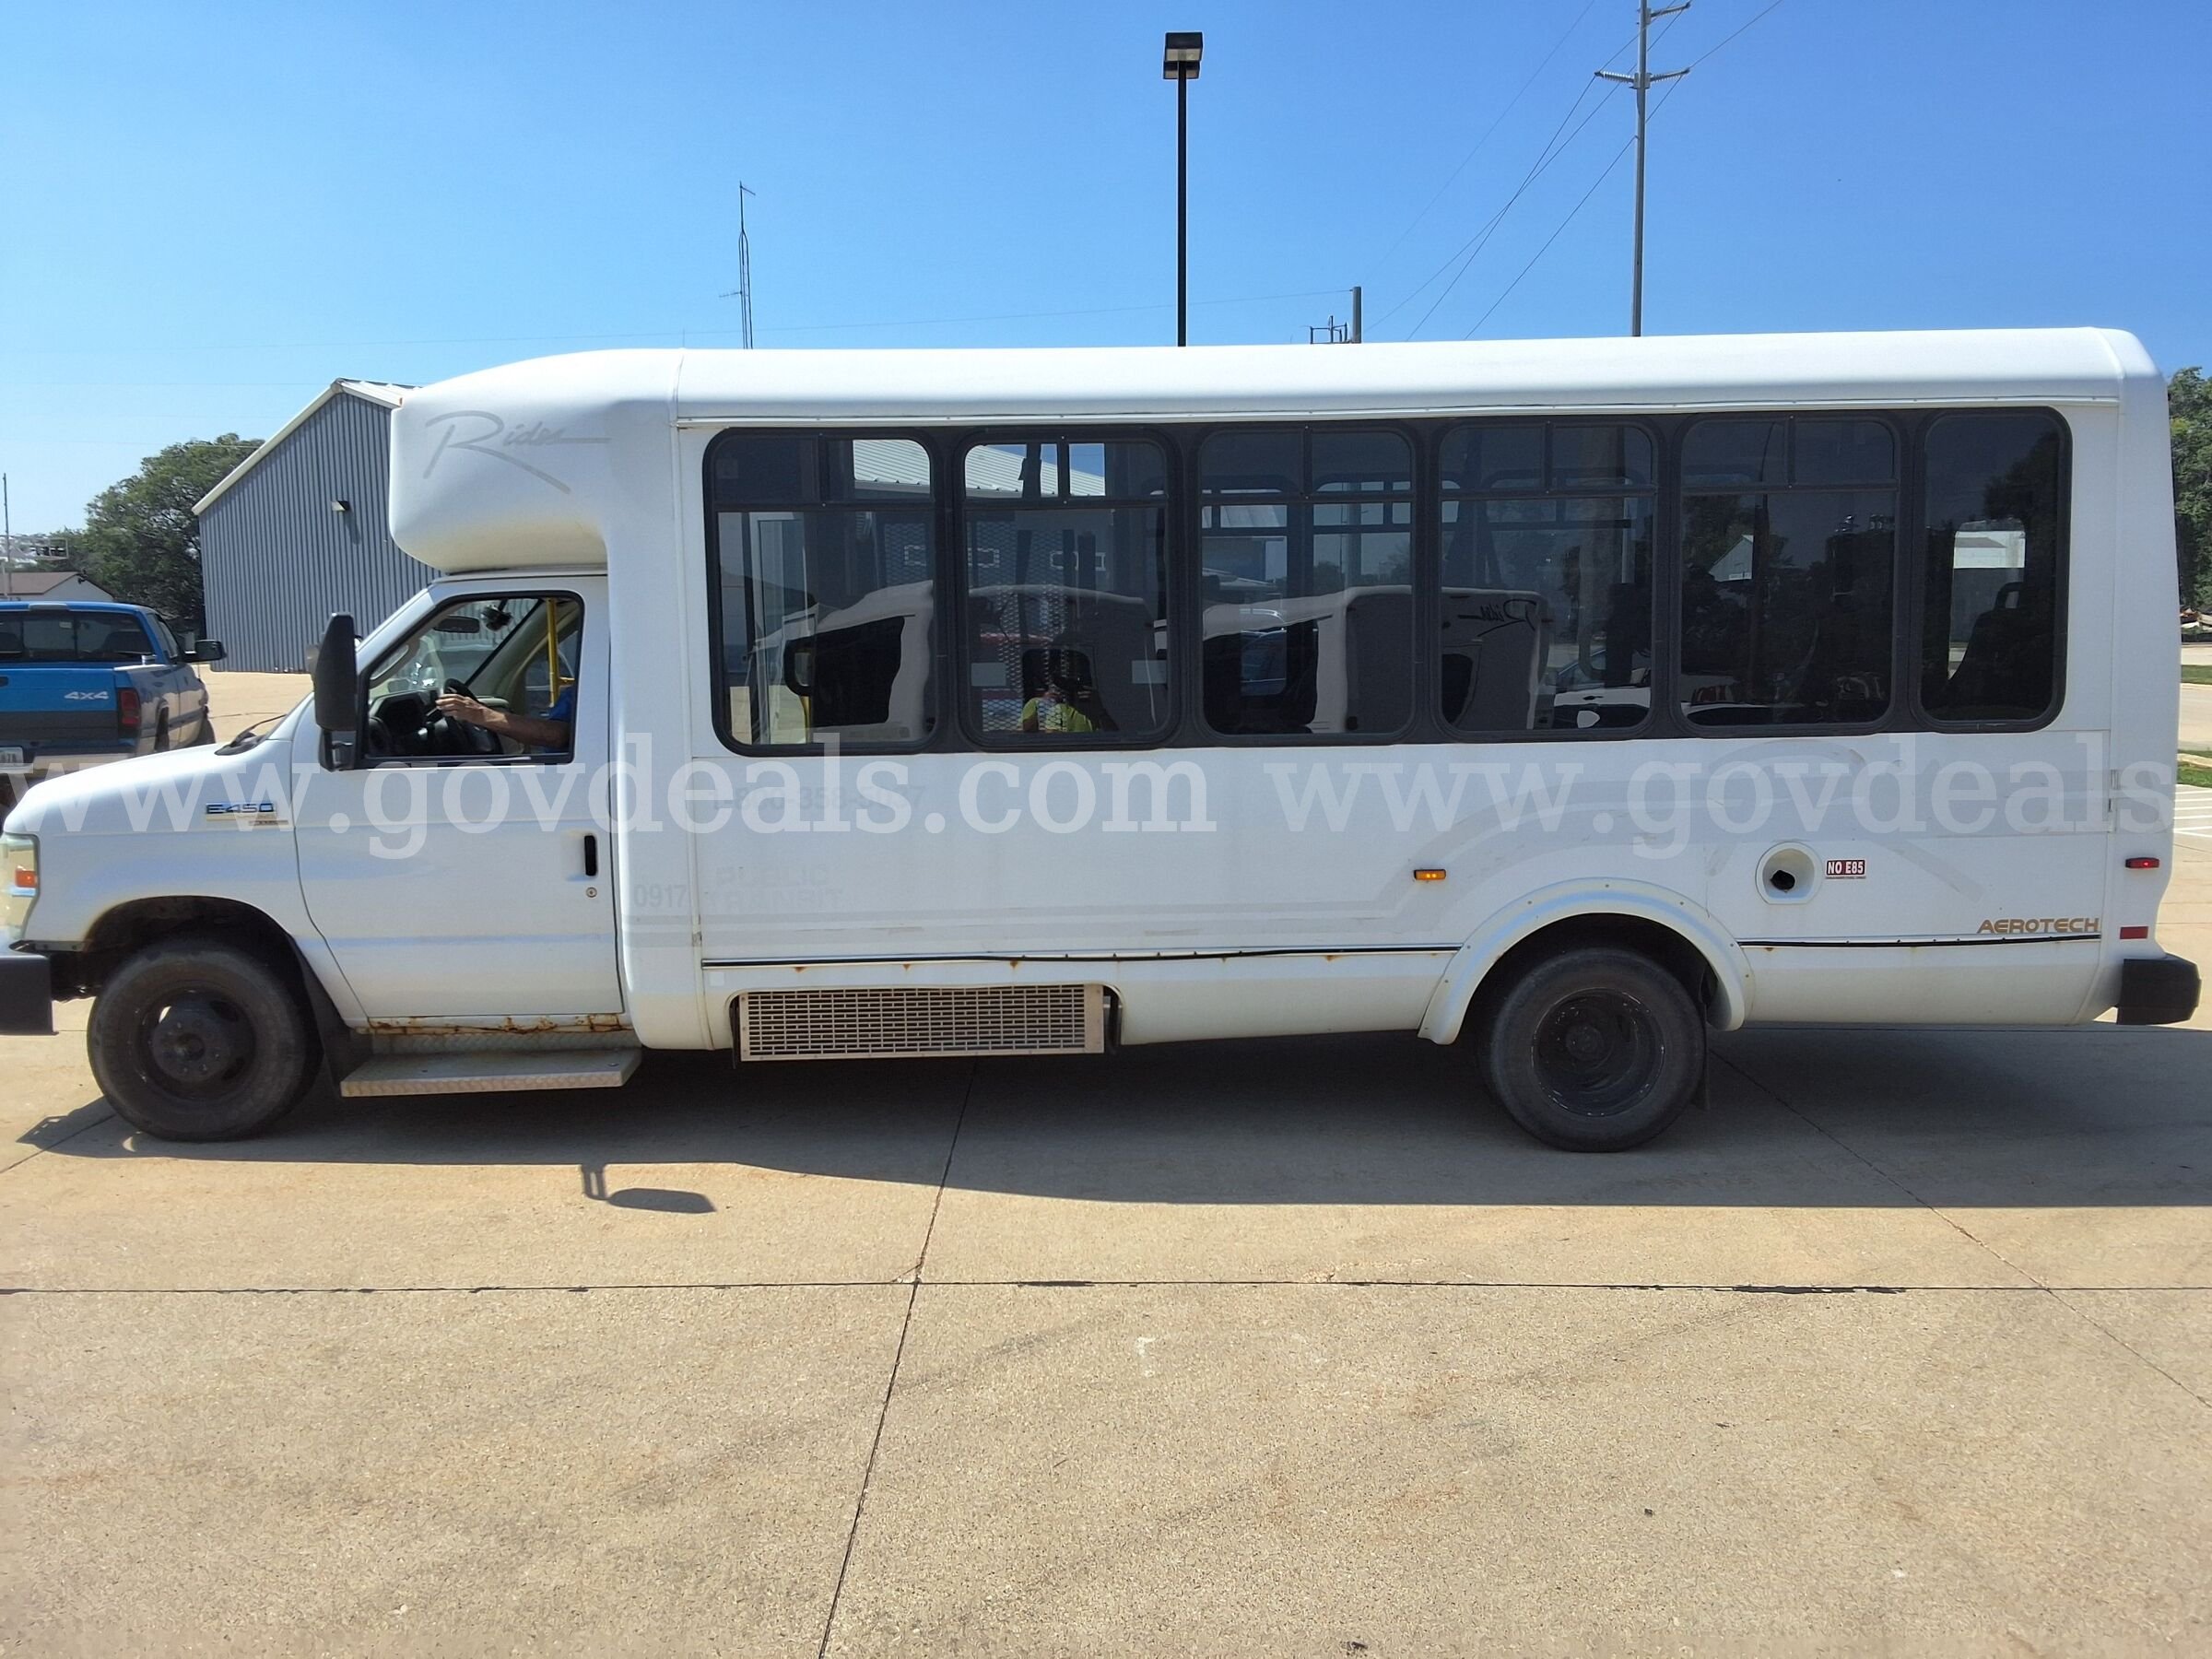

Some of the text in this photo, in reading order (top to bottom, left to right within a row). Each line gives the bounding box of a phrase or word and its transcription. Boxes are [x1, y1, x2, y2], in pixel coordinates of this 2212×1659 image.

[1827, 861, 1864, 875] NO E85
[633, 883, 688, 909] 0917
[1976, 918, 2100, 934] AEROTECH
